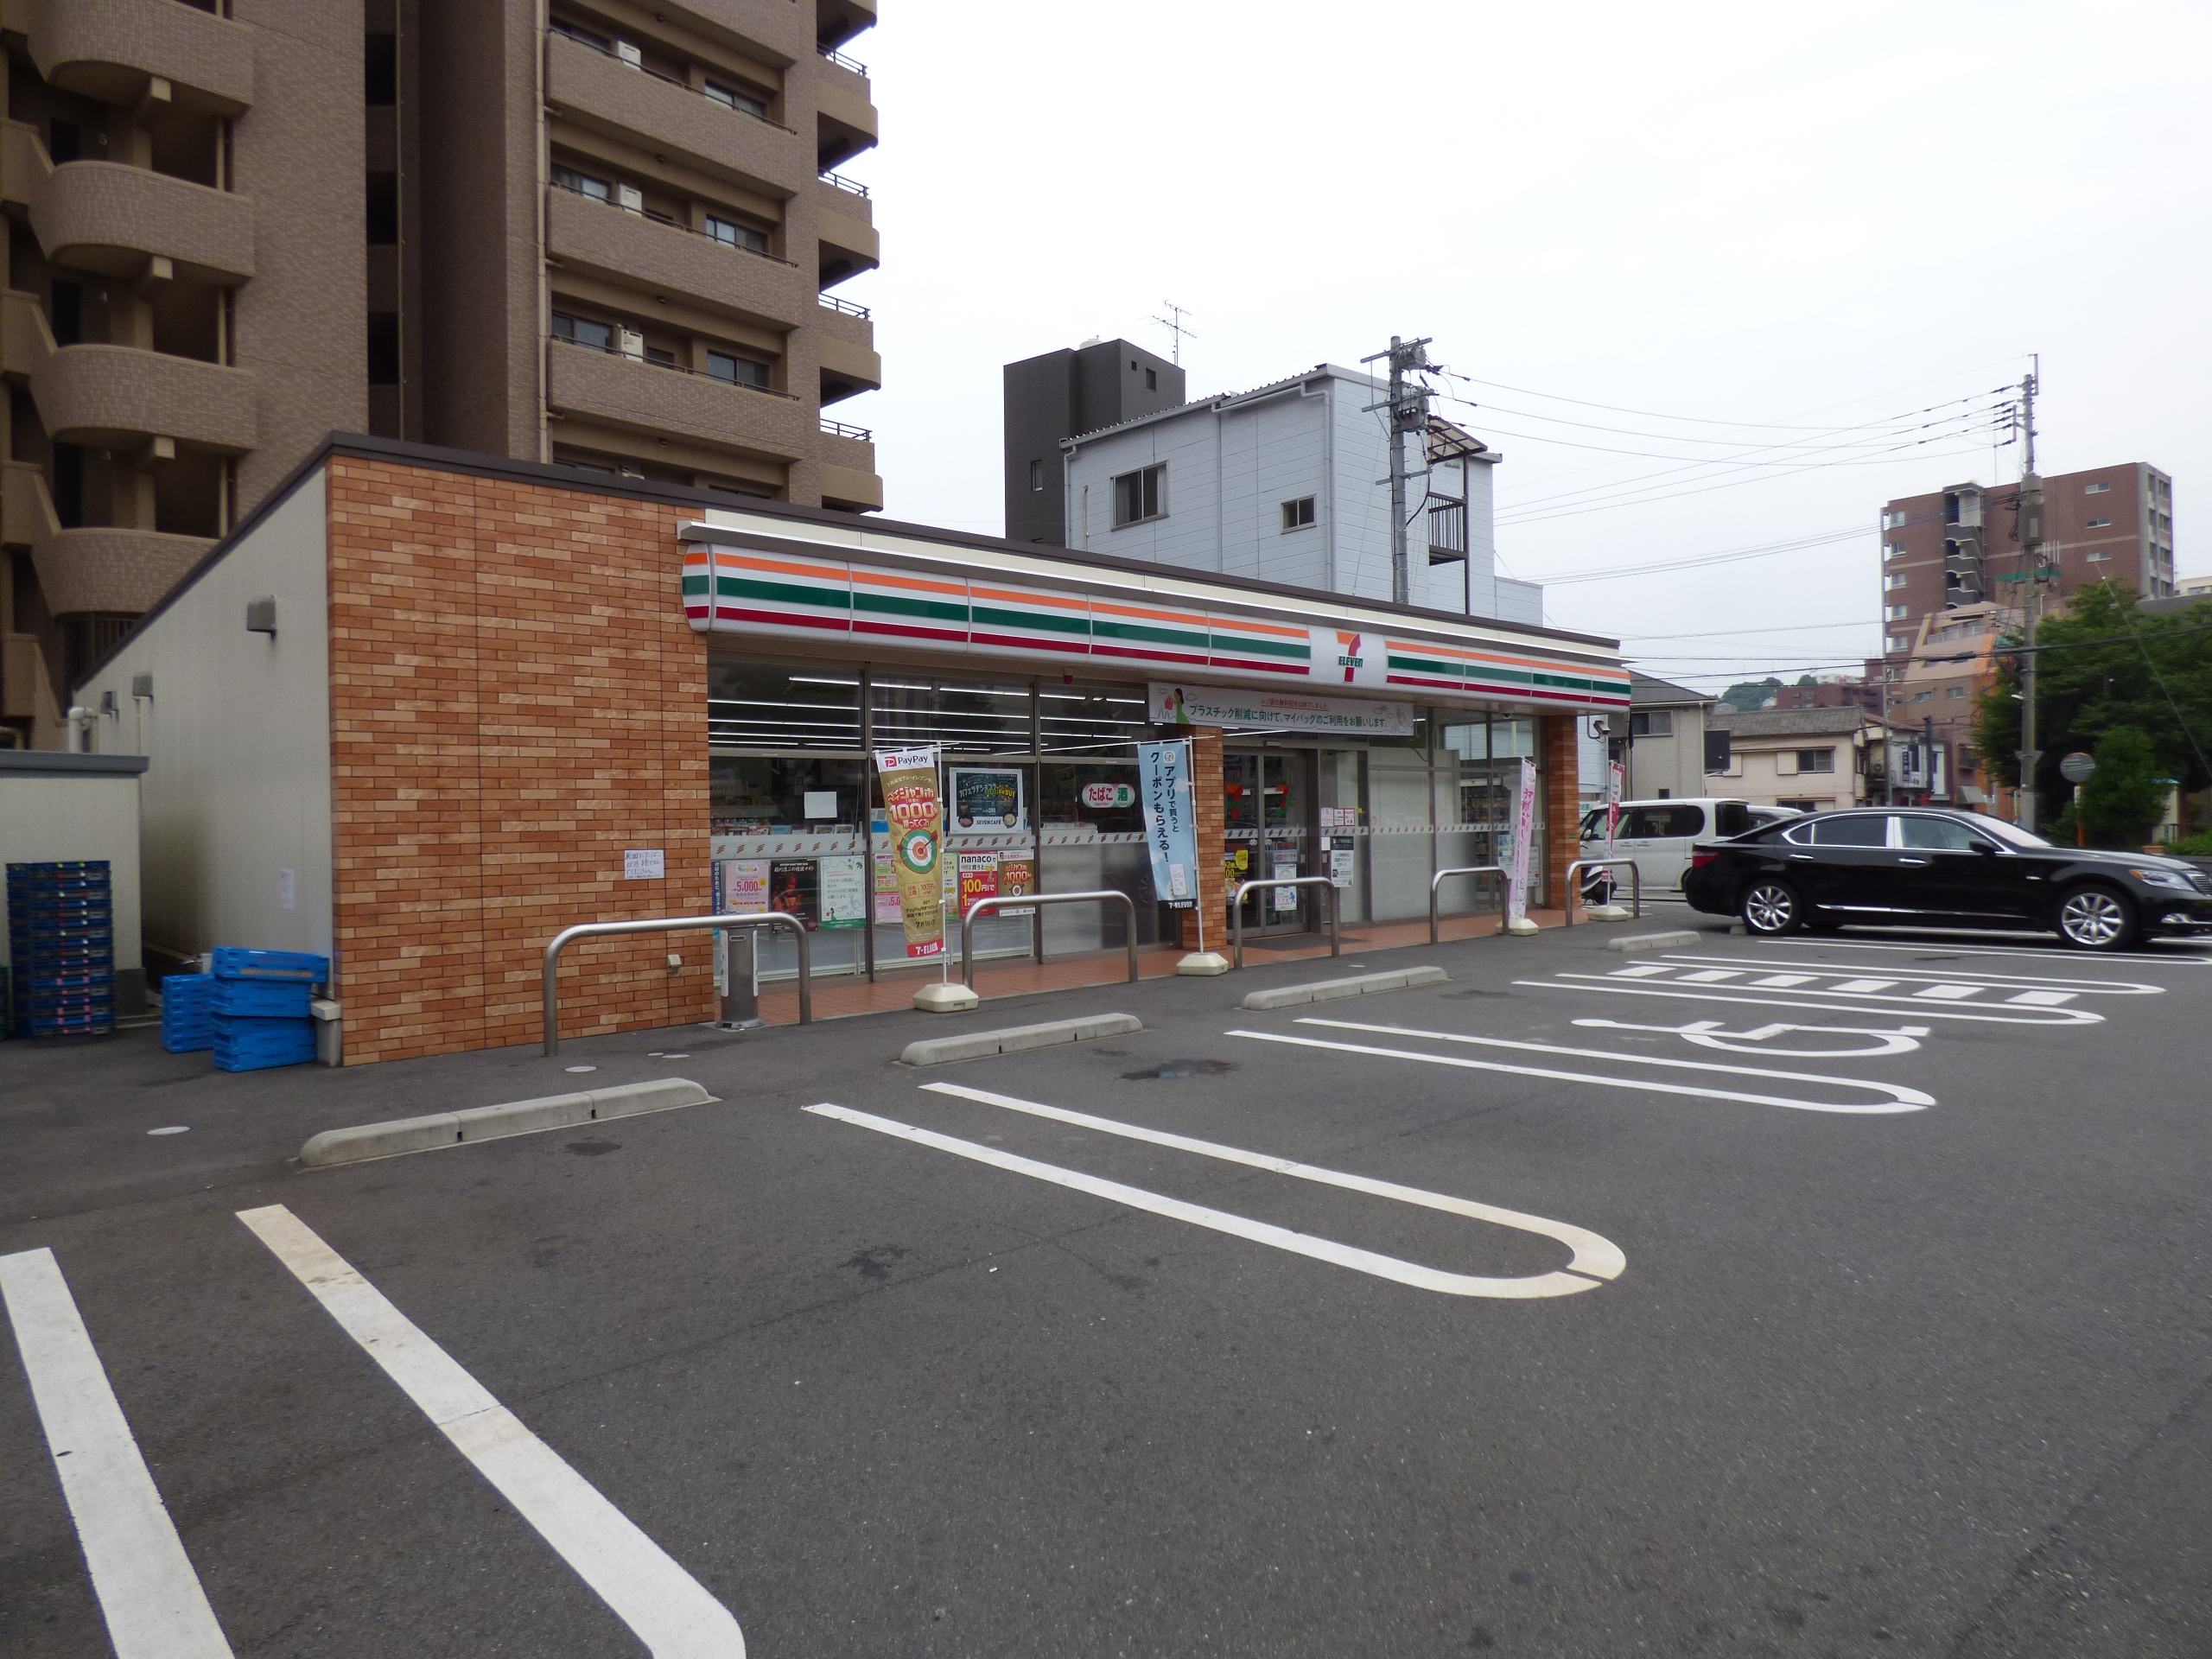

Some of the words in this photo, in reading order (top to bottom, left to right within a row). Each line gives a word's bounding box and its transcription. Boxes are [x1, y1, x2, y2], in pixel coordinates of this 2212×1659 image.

[898, 755, 928, 765] PayPay
[1089, 787, 1113, 801] たばこ
[1118, 787, 1128, 801] 酒
[1165, 766, 1179, 833] アプリで買うと
